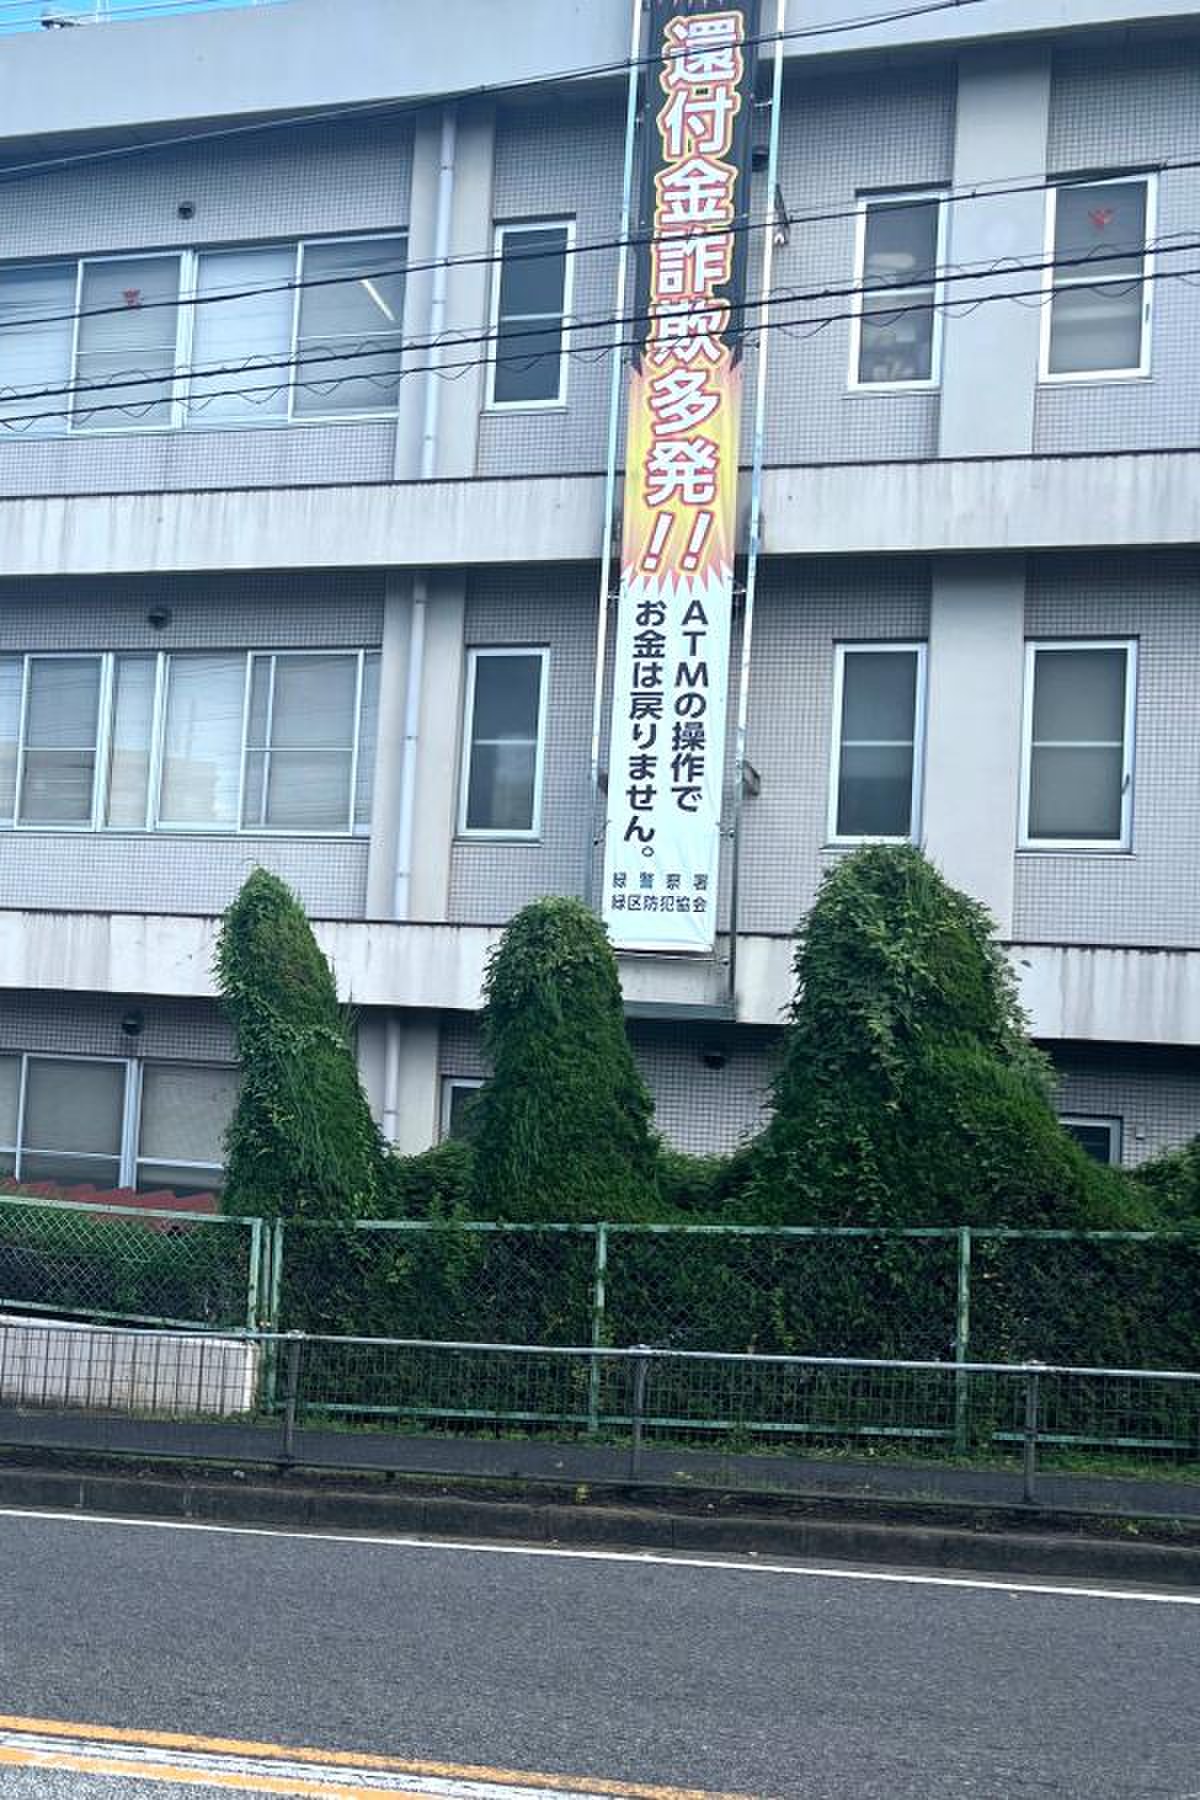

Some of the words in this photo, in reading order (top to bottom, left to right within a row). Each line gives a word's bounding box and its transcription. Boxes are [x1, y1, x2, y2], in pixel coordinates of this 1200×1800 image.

[644, 13, 740, 571] 還付金詐欺多発!!
[624, 600, 667, 858] お金は戻りません。
[670, 599, 709, 813] ATMの操作で
